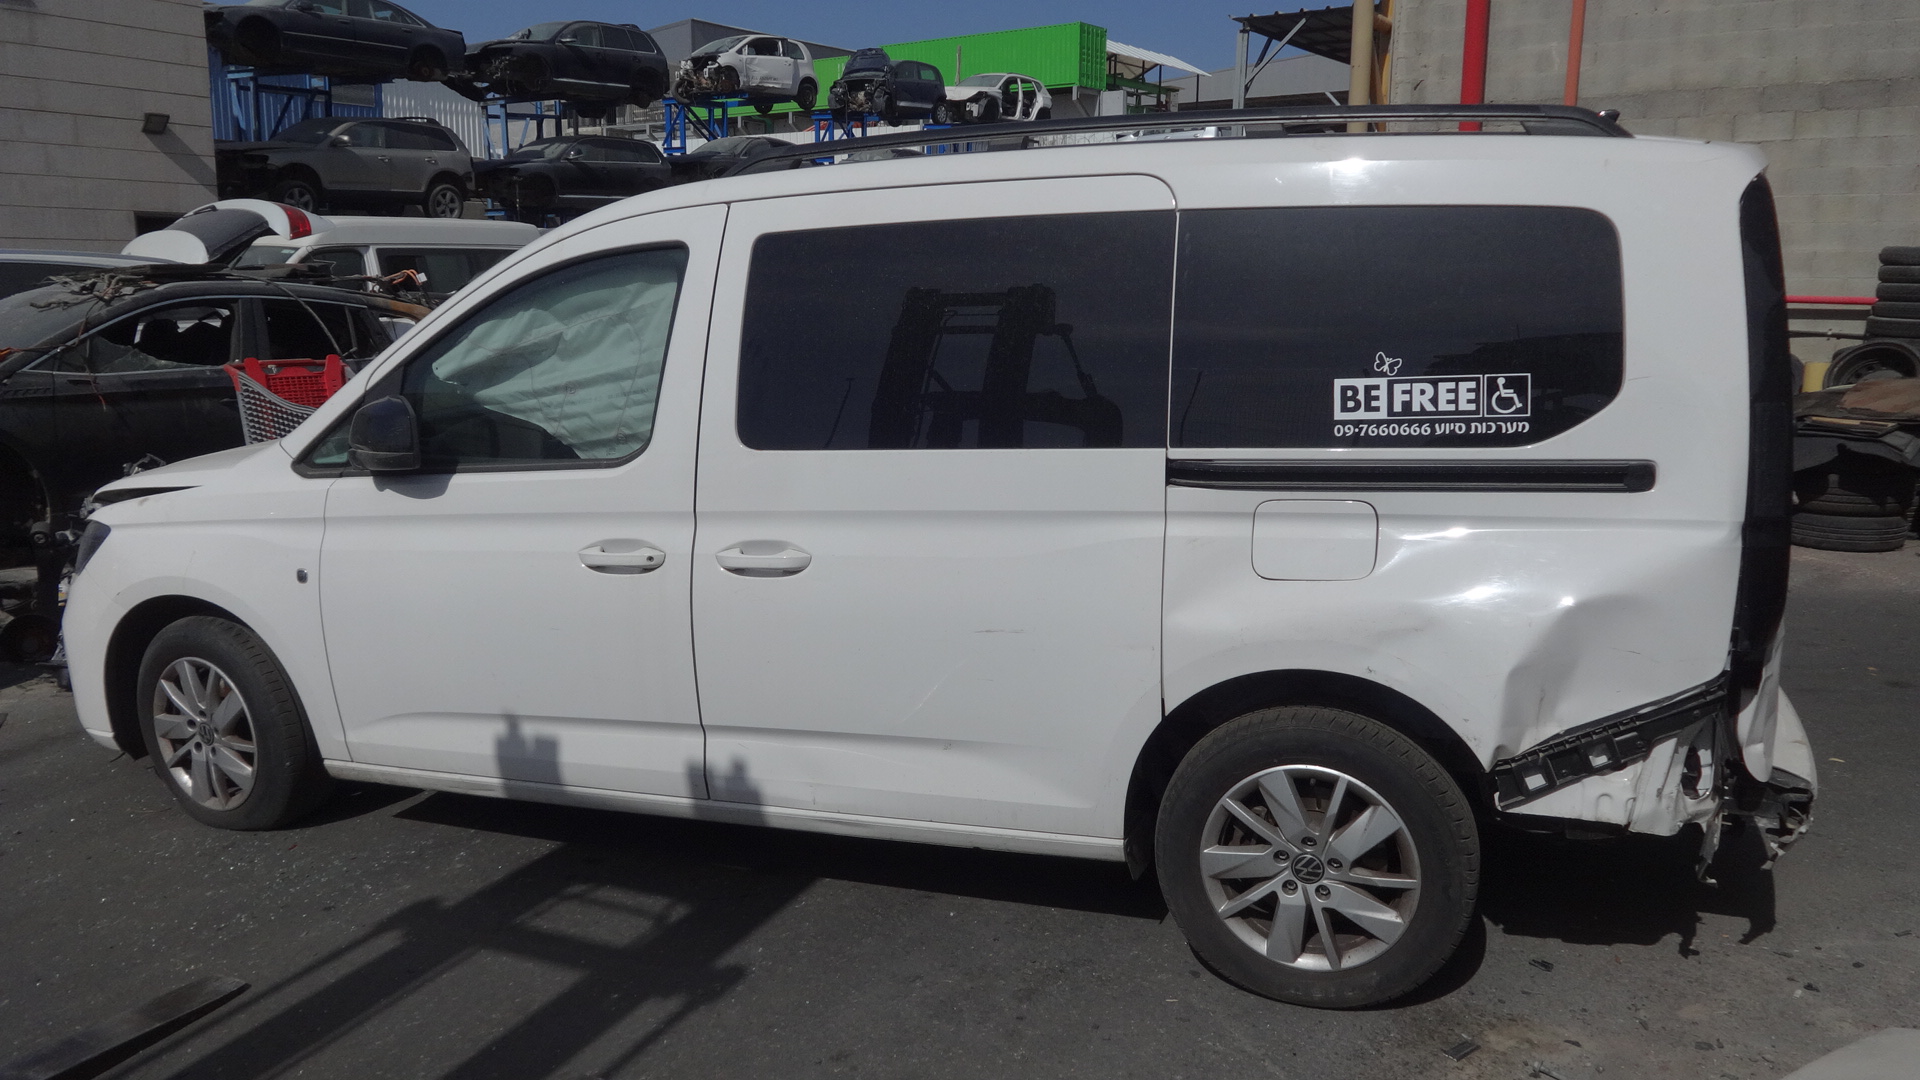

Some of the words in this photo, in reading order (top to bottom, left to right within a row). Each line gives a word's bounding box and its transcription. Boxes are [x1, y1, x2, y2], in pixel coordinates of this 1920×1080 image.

[1339, 384, 1381, 413] BE
[1393, 381, 1477, 413] FREE
[1434, 422, 1466, 436] סיוע
[1469, 421, 1530, 435] מערכות
